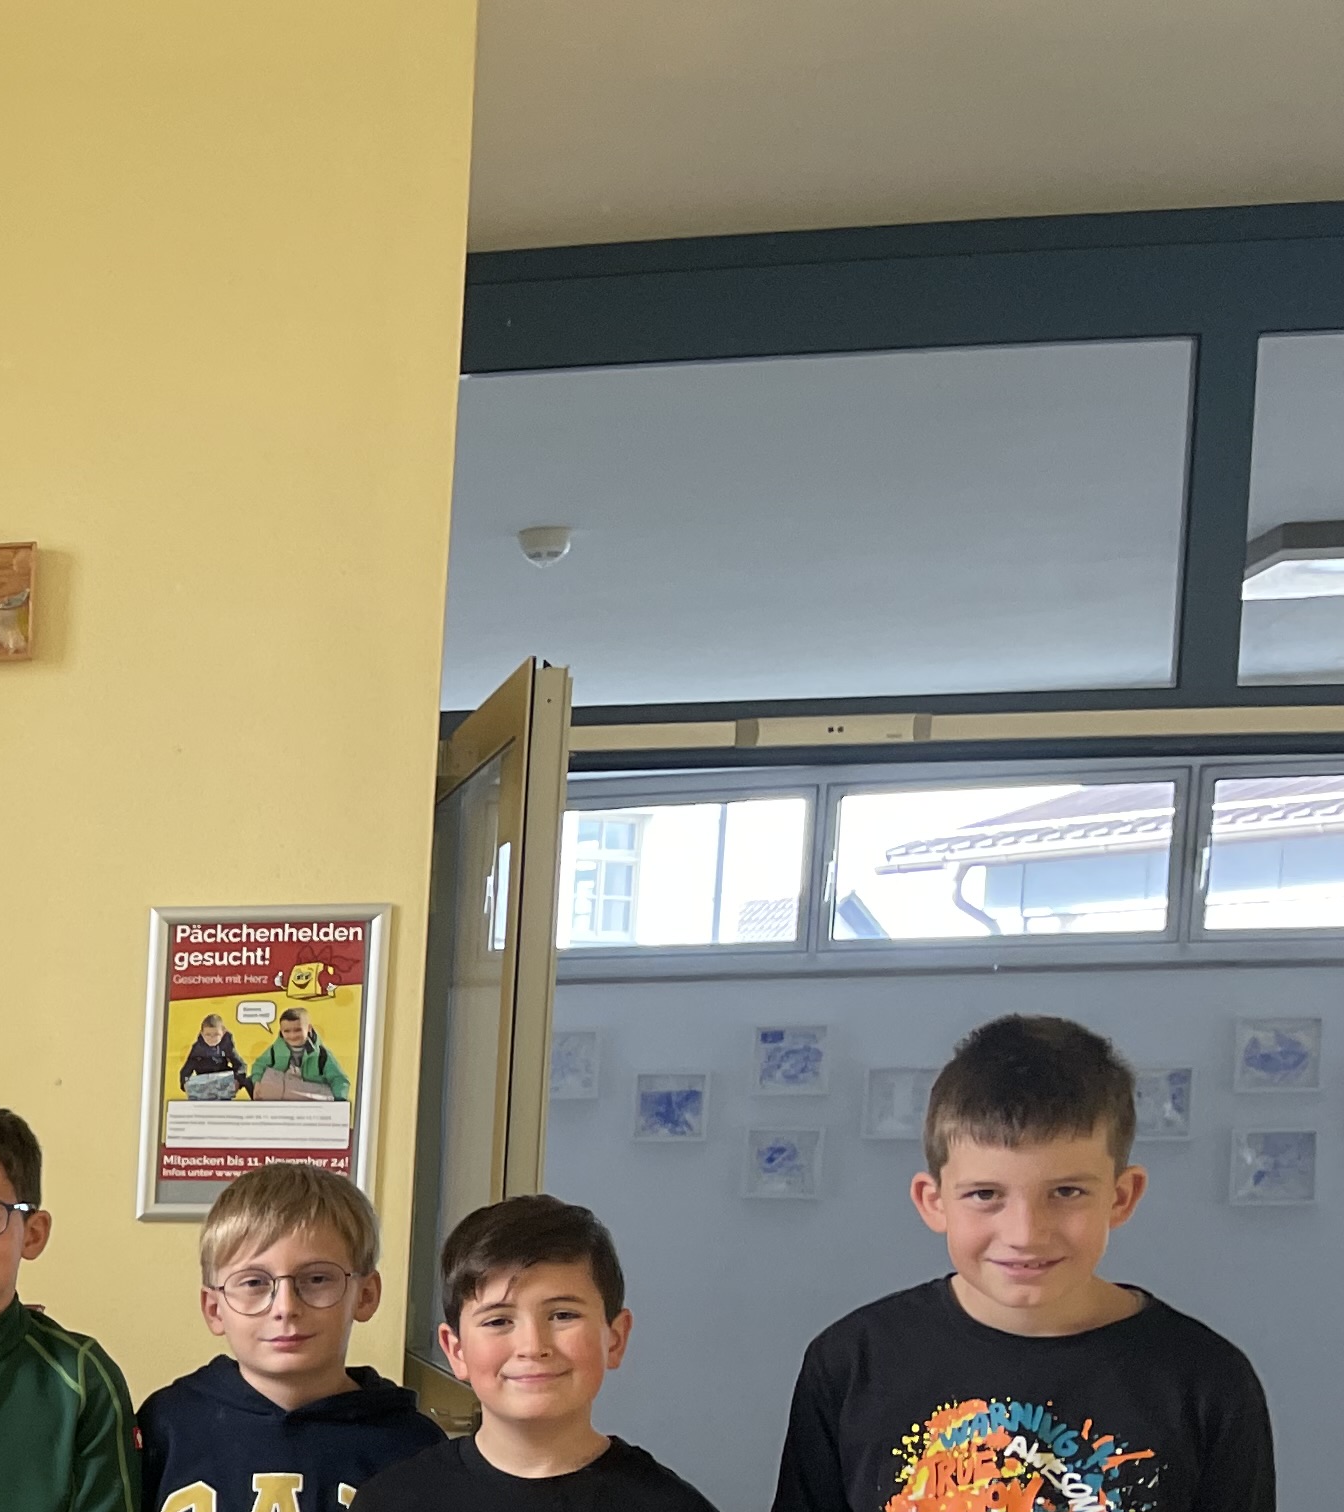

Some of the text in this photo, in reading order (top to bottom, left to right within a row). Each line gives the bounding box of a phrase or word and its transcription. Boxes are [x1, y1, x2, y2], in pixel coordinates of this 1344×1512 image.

[175, 922, 363, 944] Päckchenhelden
[174, 946, 271, 971] gesucht!
[173, 974, 268, 985] Geschenk mit Herz
[162, 1154, 224, 1168] Mitpacken
[226, 1154, 244, 1166] bis
[246, 1157, 262, 1167] 11.
[330, 1156, 349, 1169] 24!
[162, 1167, 186, 1177] Infos
[187, 1168, 214, 1177] unter
